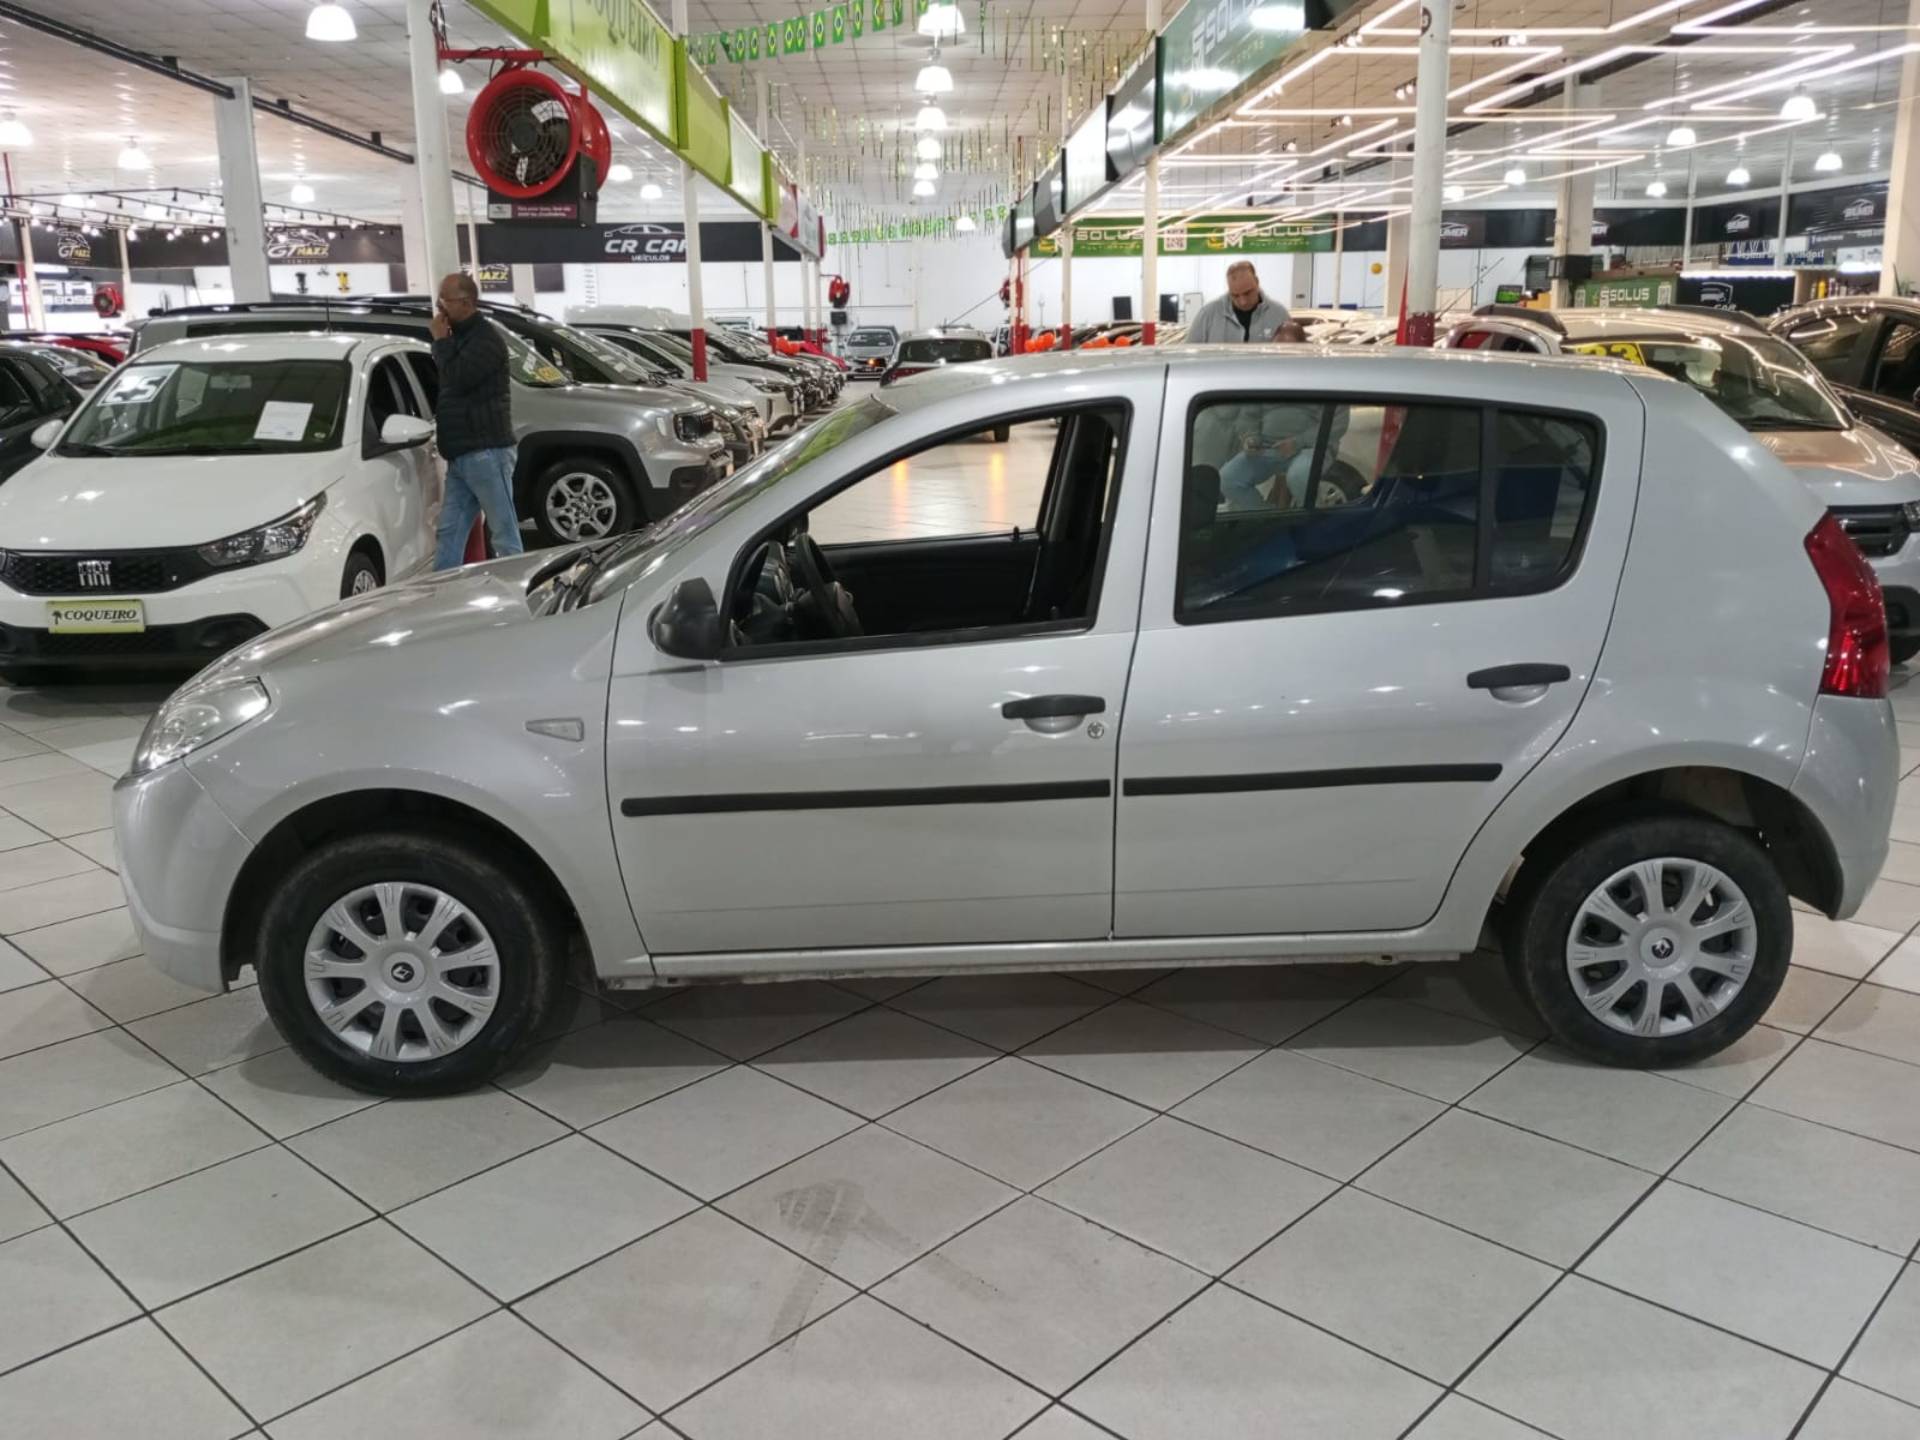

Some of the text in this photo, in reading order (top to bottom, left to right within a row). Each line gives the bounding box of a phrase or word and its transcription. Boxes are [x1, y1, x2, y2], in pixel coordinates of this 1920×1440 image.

[586, 0, 660, 71] QUEIRO
[604, 239, 639, 253] CR
[78, 560, 111, 586] FIAT
[64, 609, 137, 621] COQUEIRO
